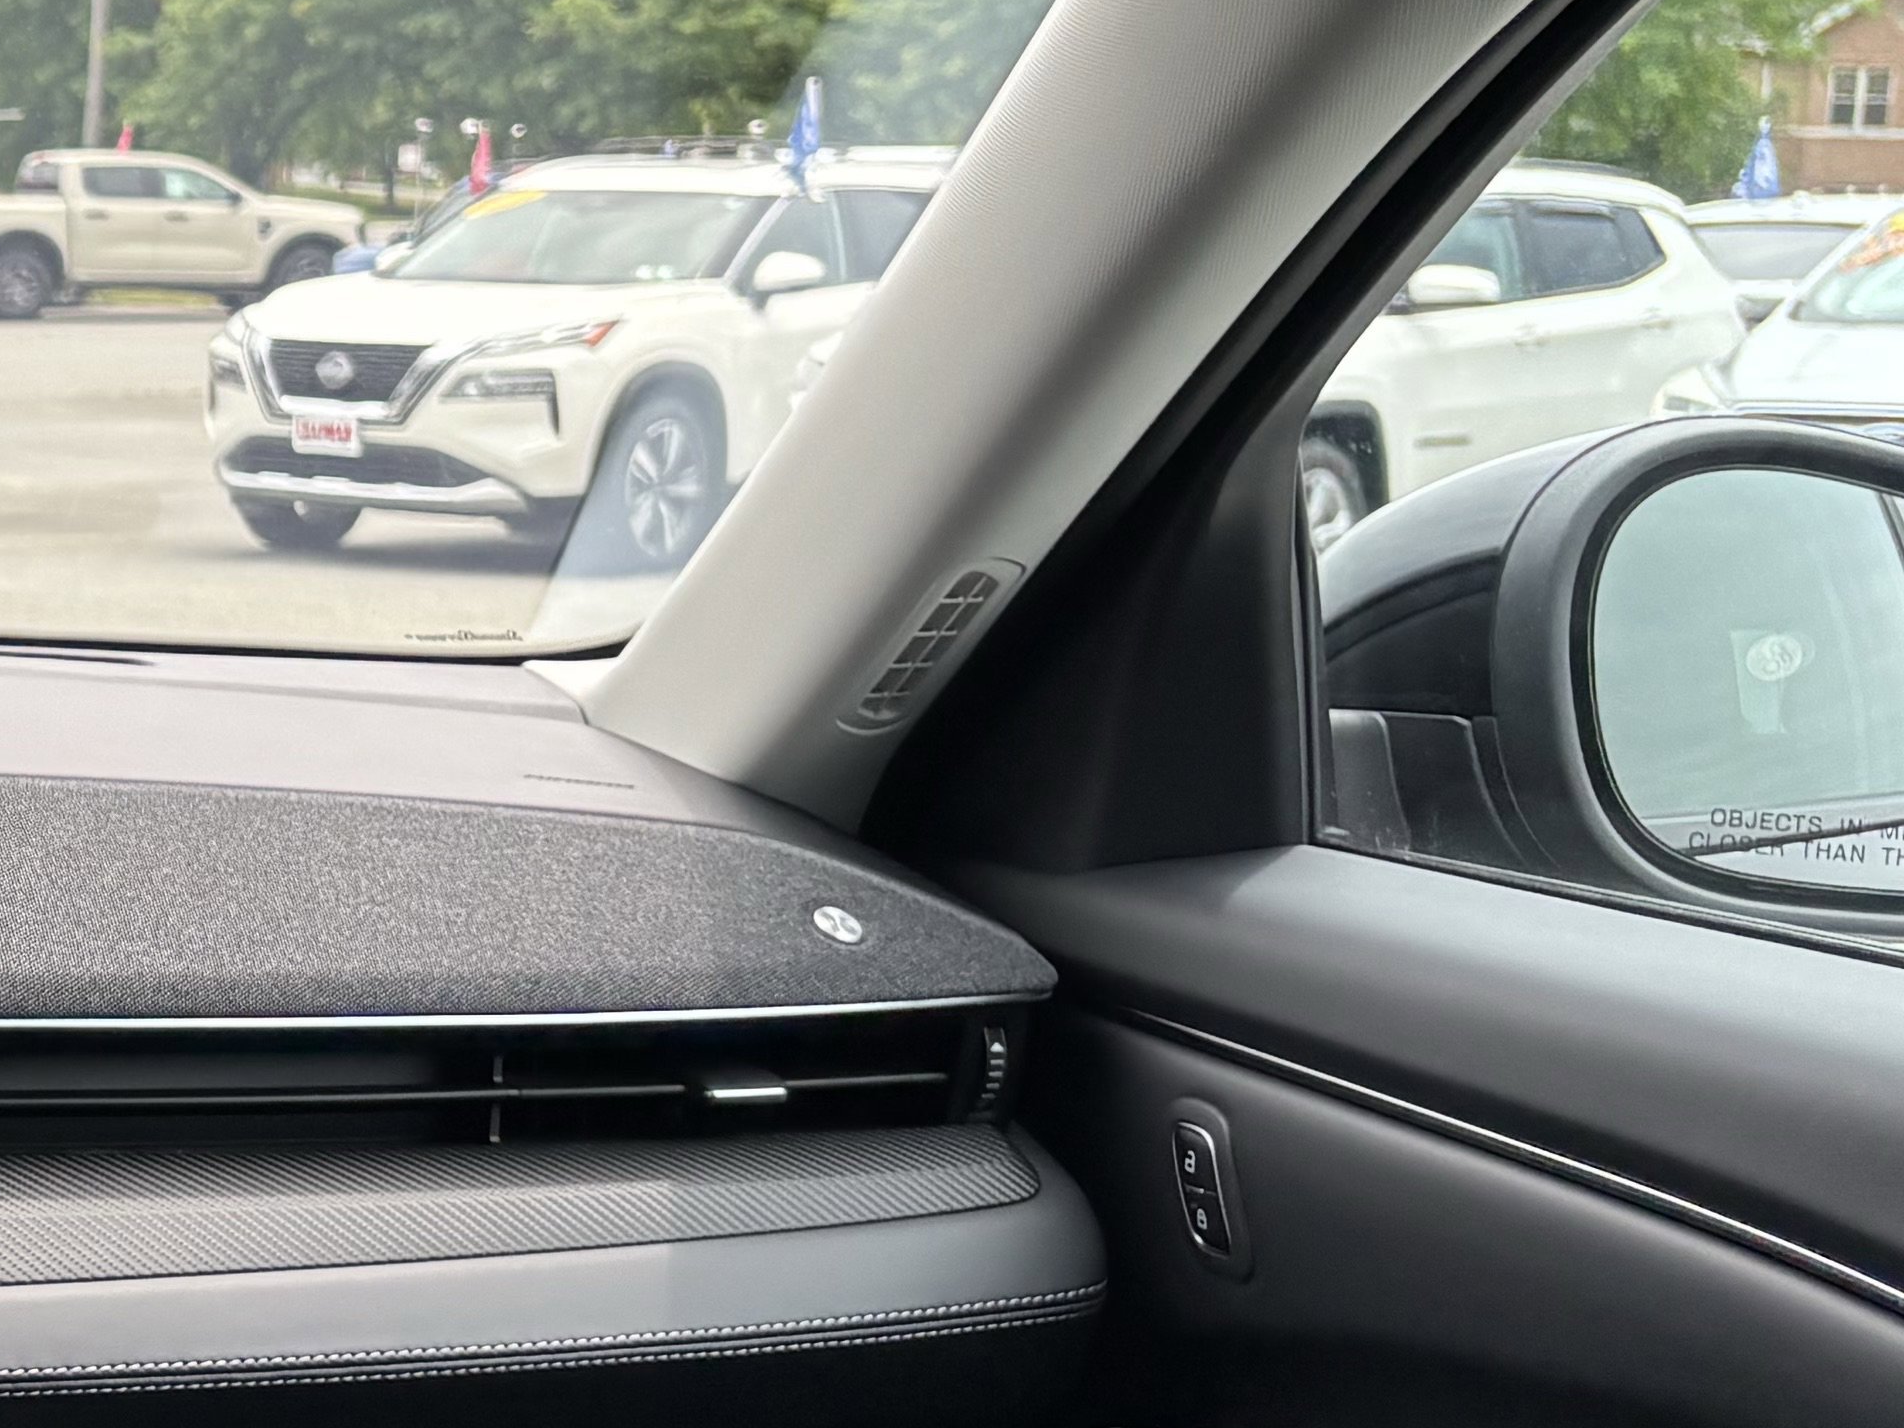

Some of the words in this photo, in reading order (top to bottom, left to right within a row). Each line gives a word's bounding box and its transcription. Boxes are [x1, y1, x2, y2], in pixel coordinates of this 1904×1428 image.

[1710, 808, 1823, 835] OBJECTS
[1838, 817, 1863, 836] IN
[1689, 831, 1786, 858] CLOSER
[1802, 840, 1865, 865] THAN
